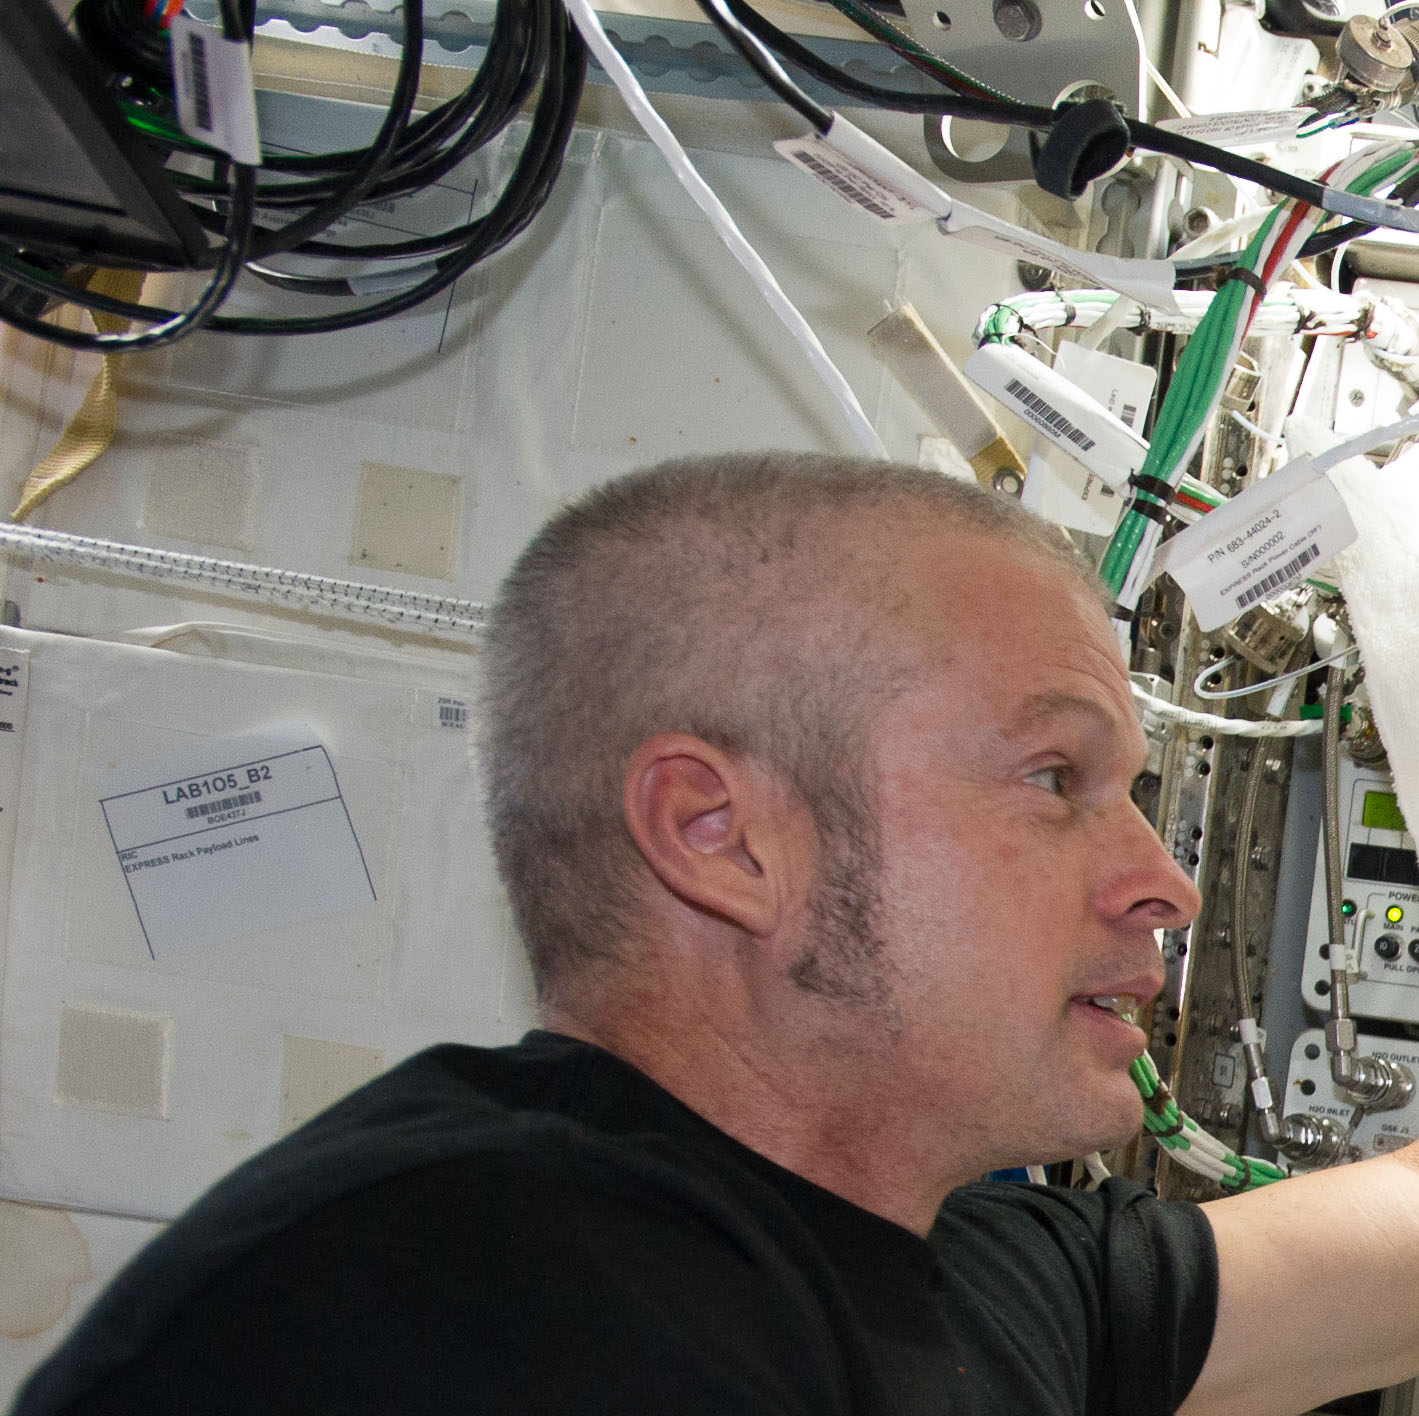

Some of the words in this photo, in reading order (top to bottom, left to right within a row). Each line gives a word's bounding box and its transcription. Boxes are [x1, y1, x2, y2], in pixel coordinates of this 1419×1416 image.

[1207, 546, 1226, 564] P/N
[1226, 508, 1282, 554] 683-44024-2
[123, 855, 170, 875] EXPRESS
[171, 847, 196, 865] Rack
[196, 840, 233, 860] Payload
[233, 833, 260, 850] Lines
